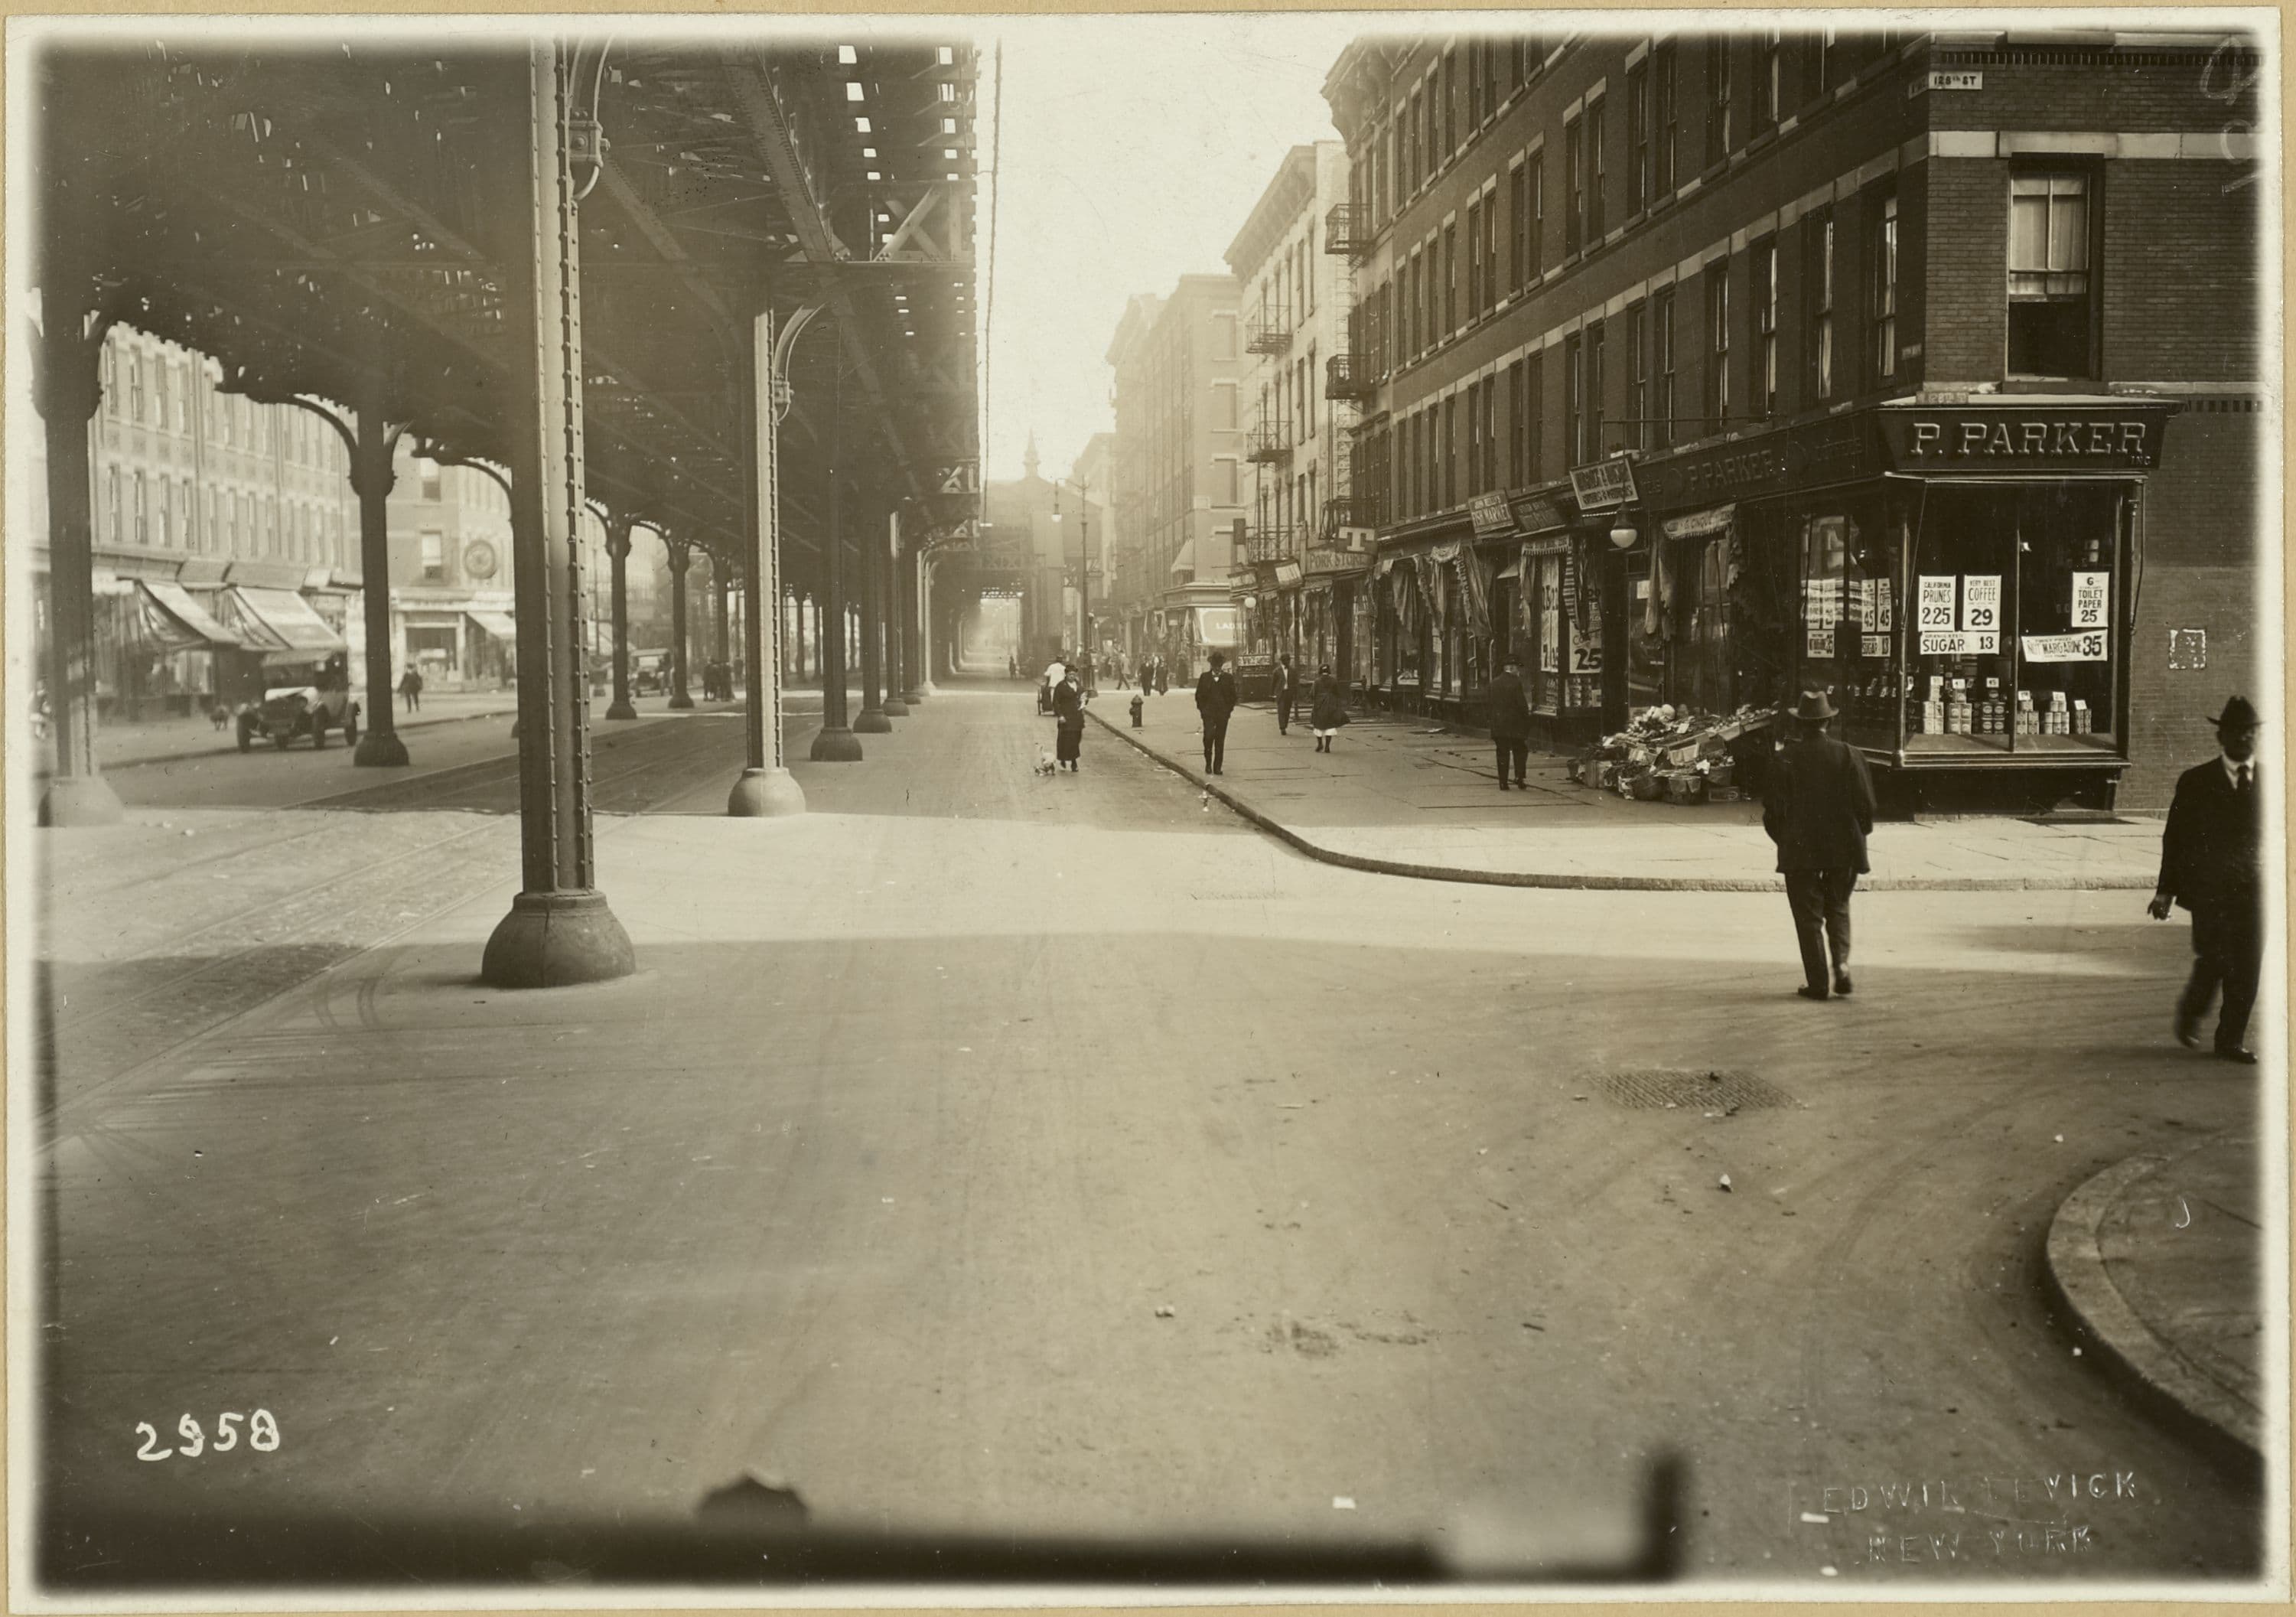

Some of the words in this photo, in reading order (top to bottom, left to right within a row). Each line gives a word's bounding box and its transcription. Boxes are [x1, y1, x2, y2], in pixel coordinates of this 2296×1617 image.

[1962, 75, 1977, 86] ST
[1956, 422, 2146, 455] PARKER
[1309, 553, 1334, 569] PORK
[2086, 576, 2094, 586] 6
[1923, 589, 1952, 603] PRUNES
[1968, 587, 1996, 601] COFFEE
[2078, 589, 2103, 599] TOILET
[2077, 599, 2102, 609] PAPER
[1971, 608, 1994, 627] 29
[2080, 609, 2099, 623] 25
[1922, 638, 1965, 652] SUGAR
[1979, 636, 1994, 650] 13
[2082, 635, 2102, 657] 35
[1574, 648, 1602, 671] 25
